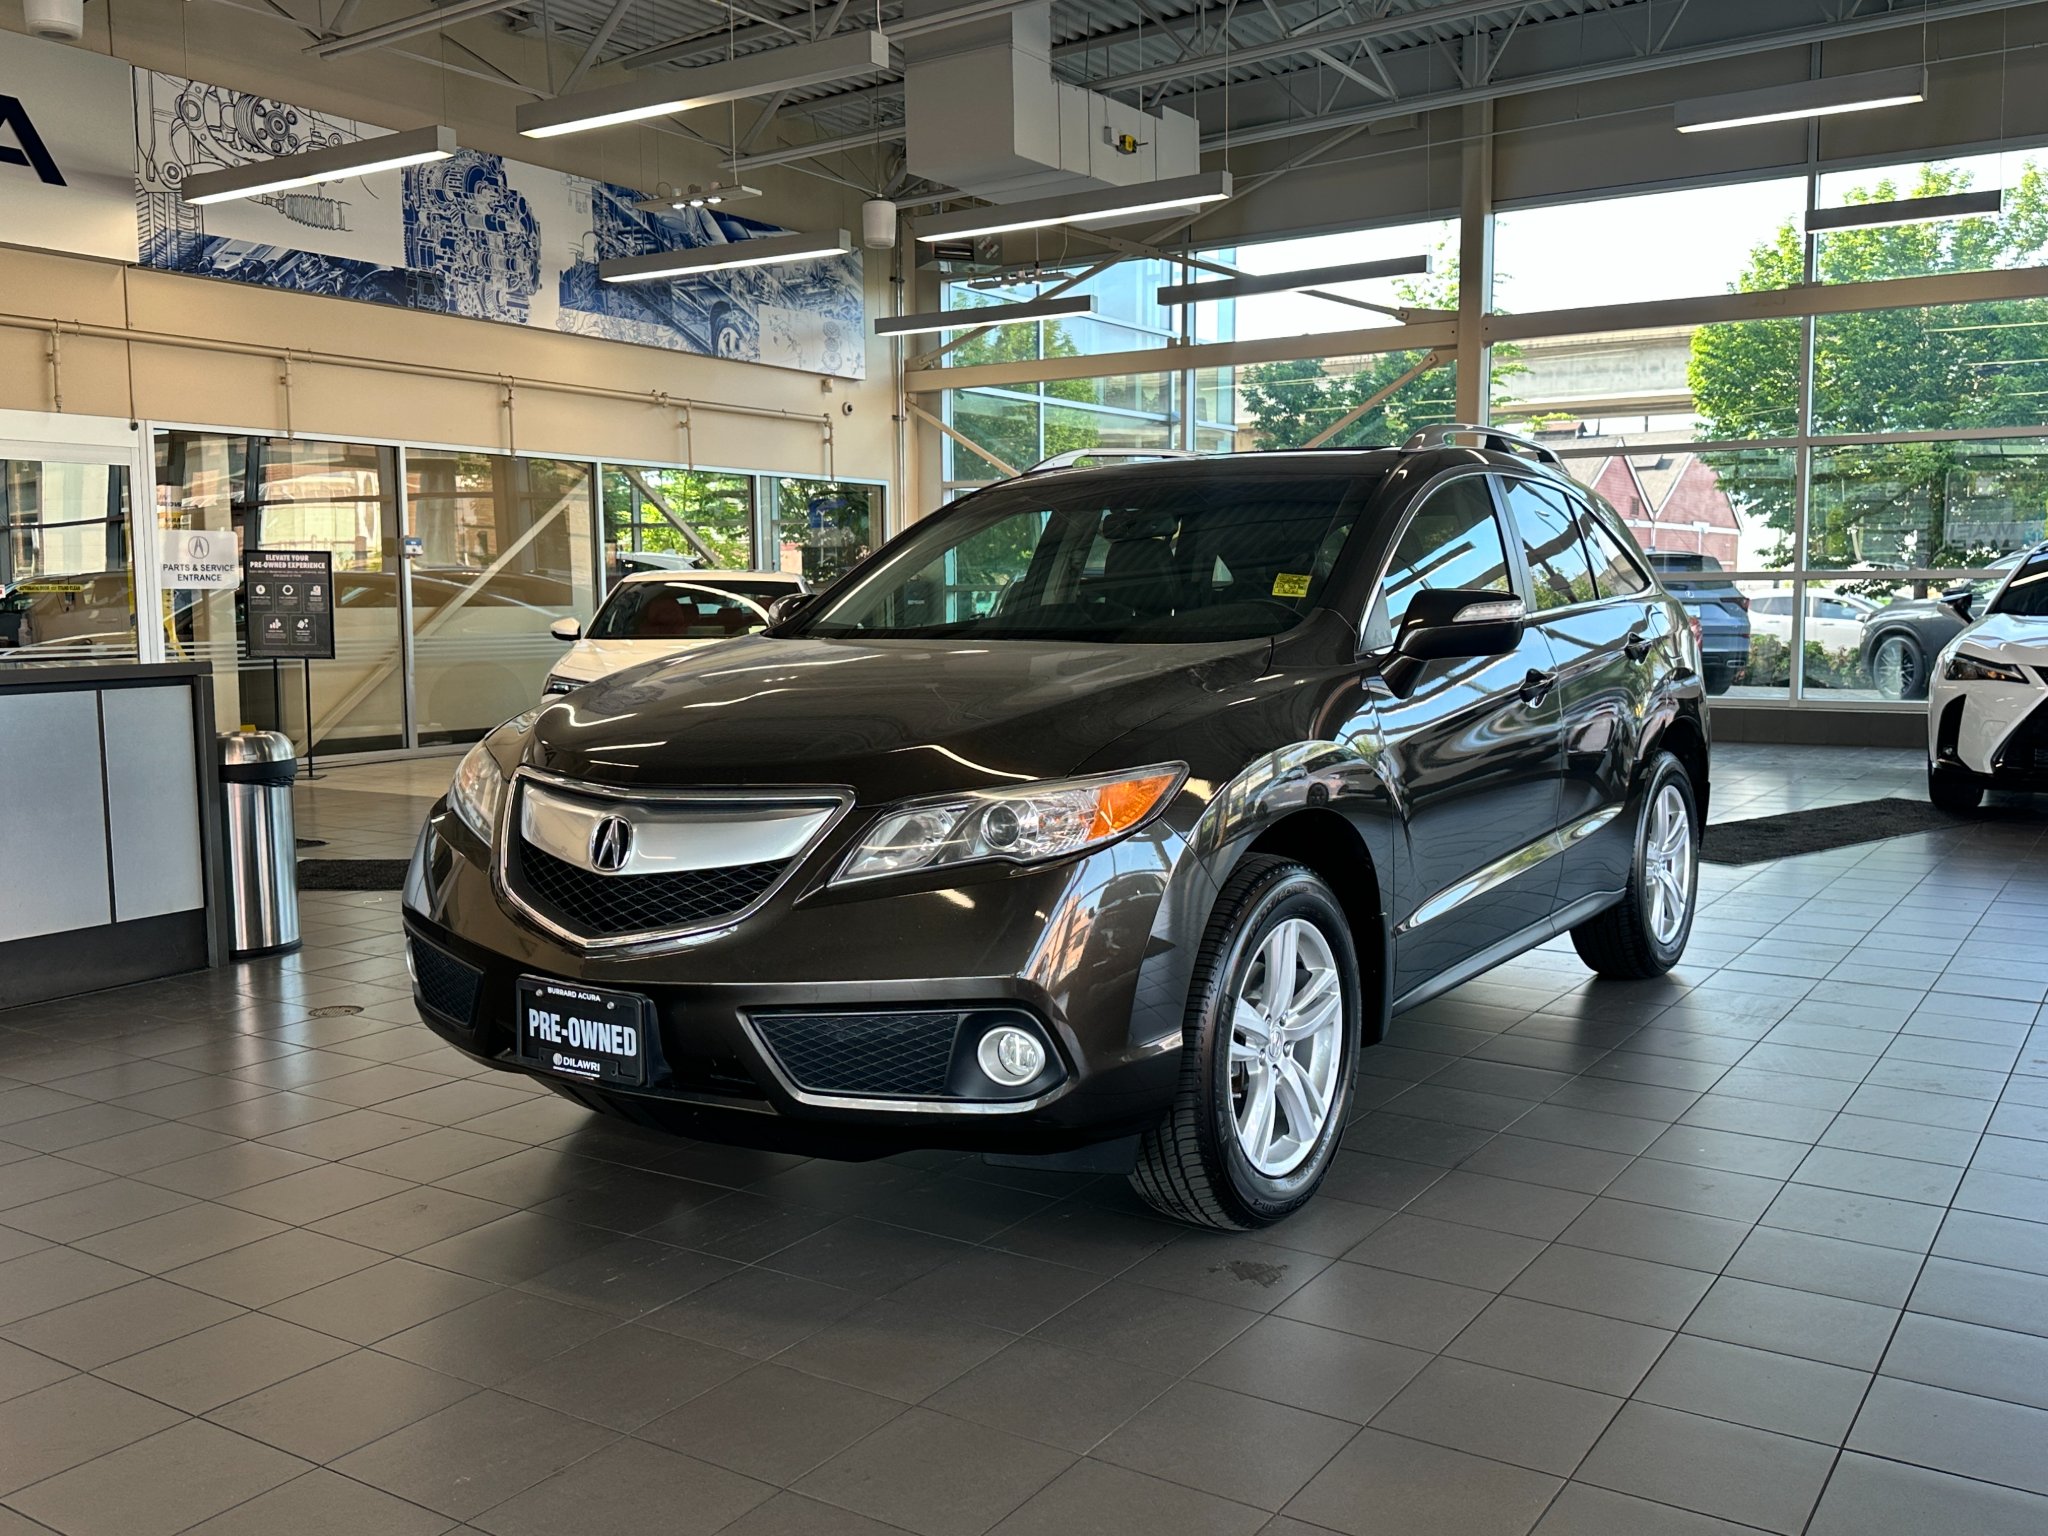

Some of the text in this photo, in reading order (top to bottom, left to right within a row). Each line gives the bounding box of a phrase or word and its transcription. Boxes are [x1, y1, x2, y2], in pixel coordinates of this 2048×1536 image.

[291, 554, 309, 562] YOUR
[162, 563, 235, 572] PARTS & SERVICE
[177, 573, 222, 581] ENTRANCE
[547, 986, 602, 1002] BURRARD ACURA
[528, 1007, 637, 1057] PRE-OWNED
[563, 1056, 601, 1072] DILAWRI
